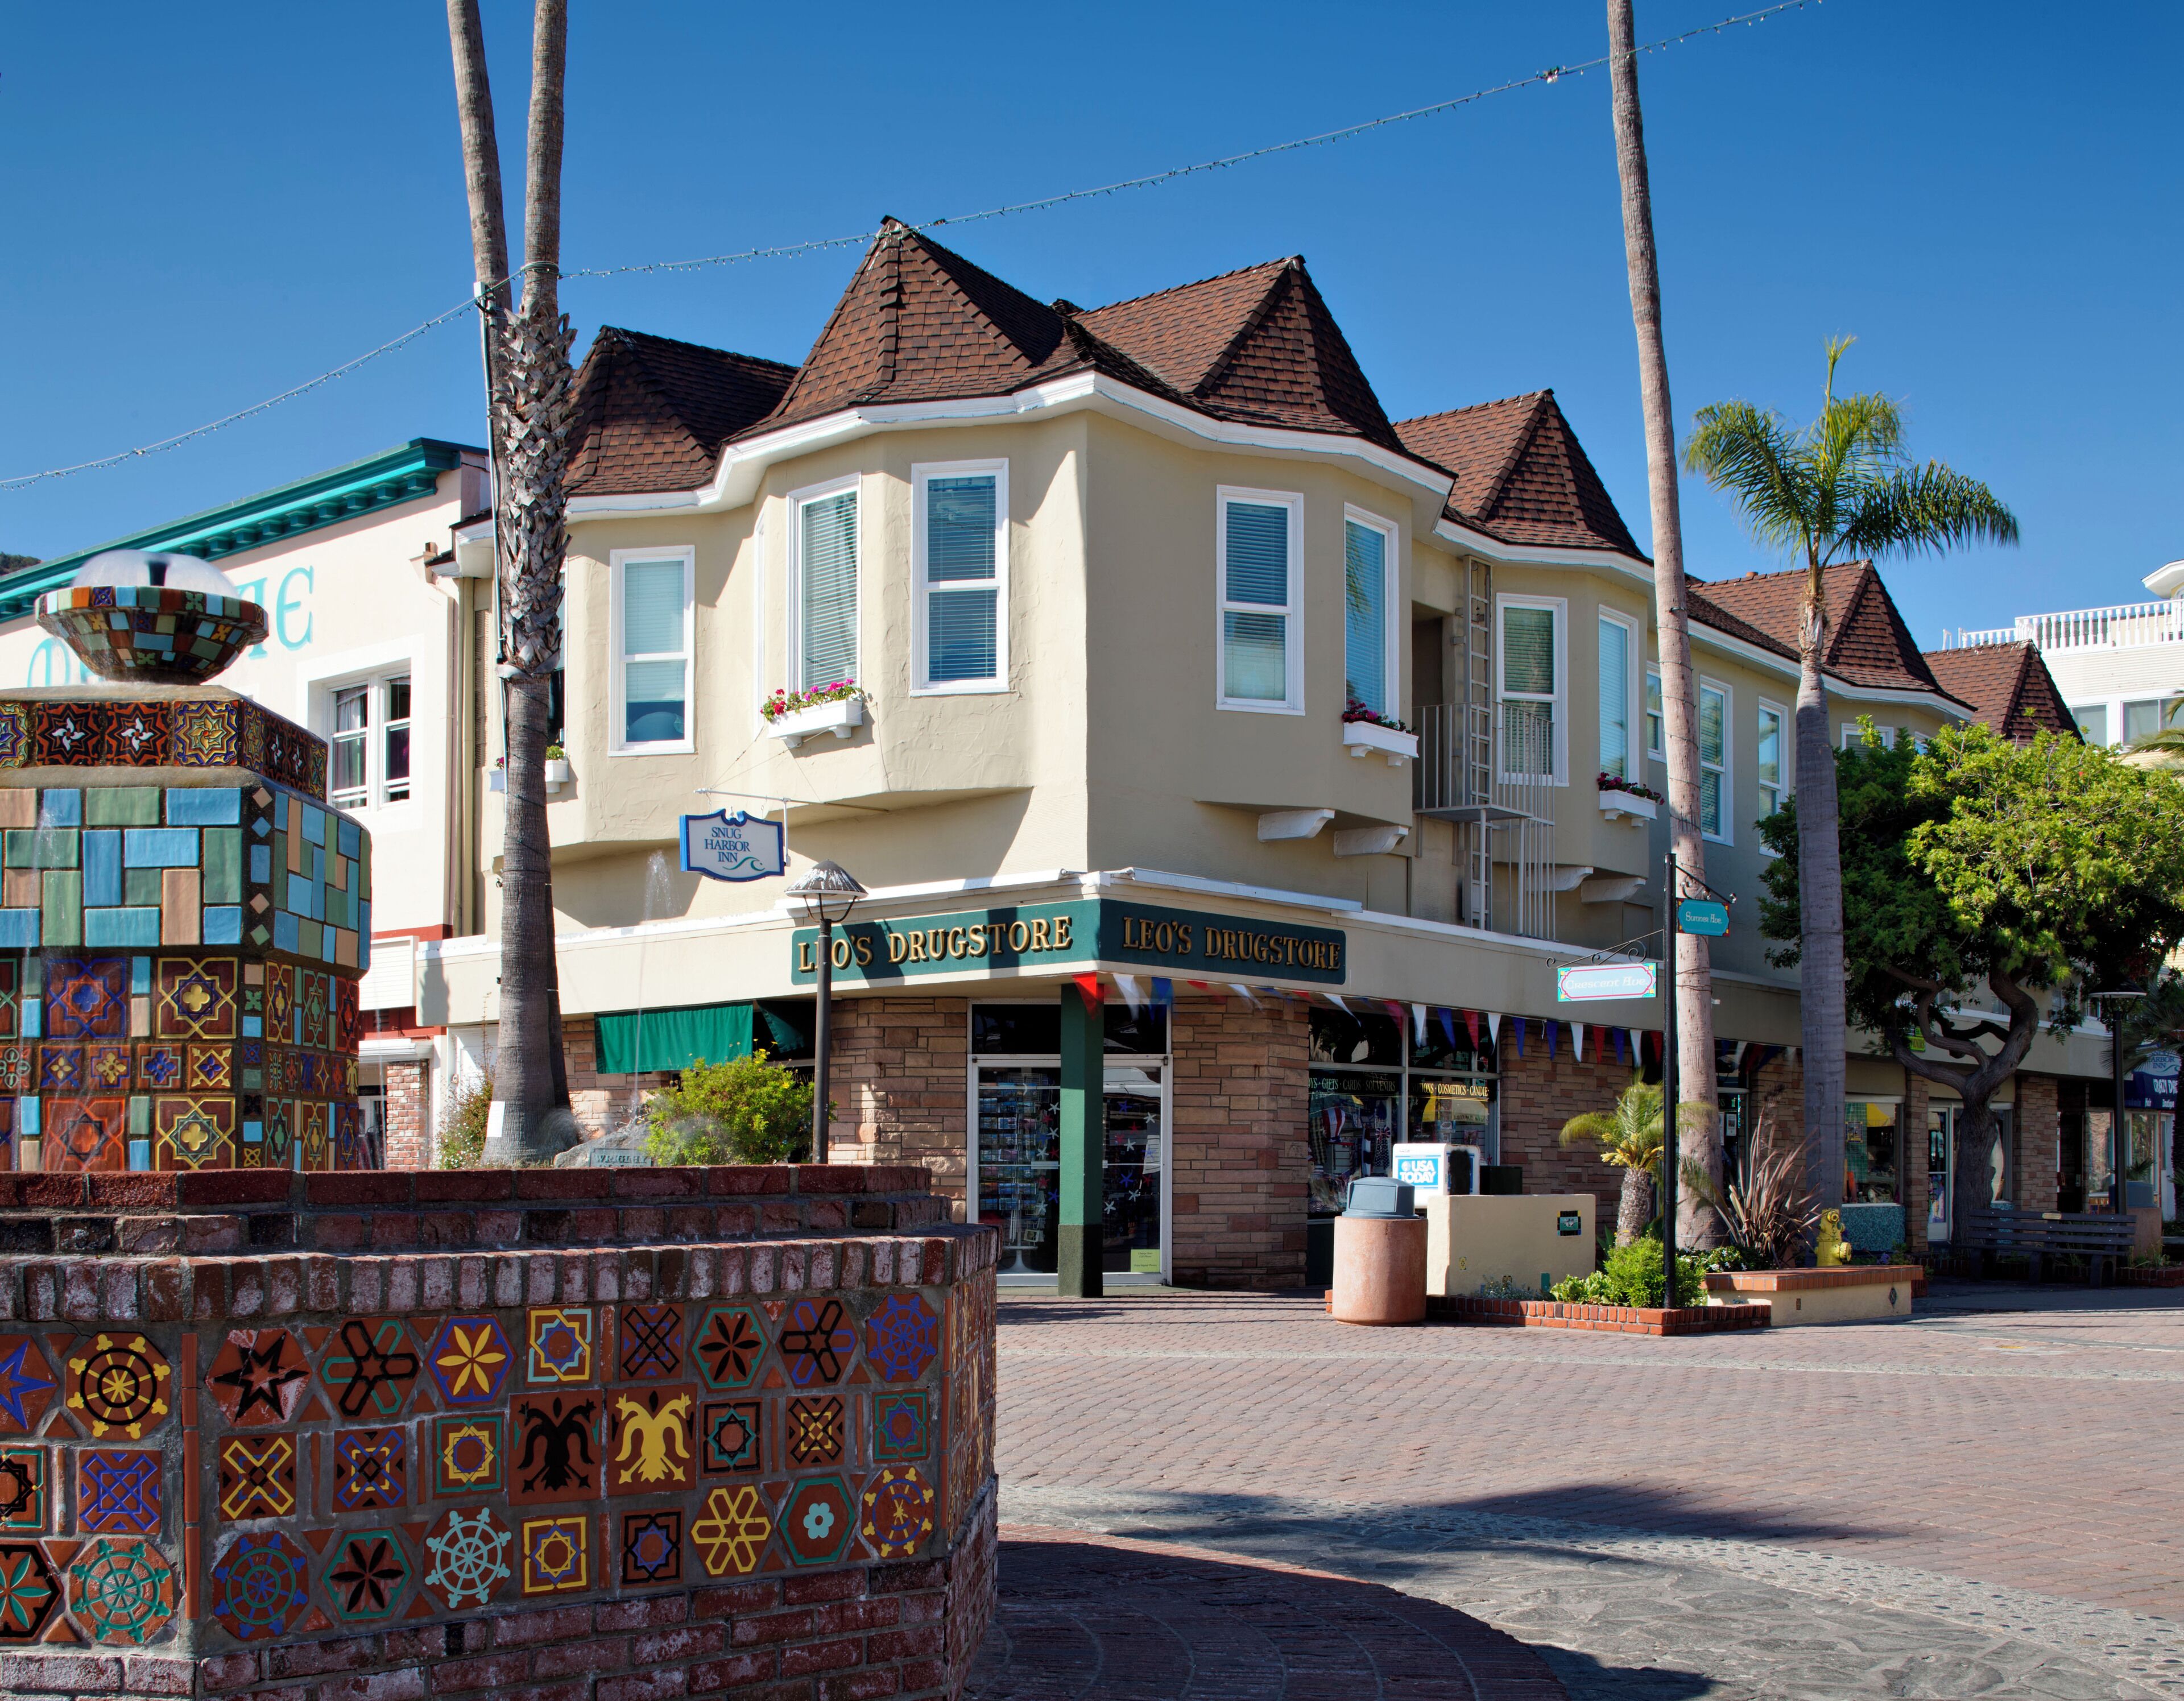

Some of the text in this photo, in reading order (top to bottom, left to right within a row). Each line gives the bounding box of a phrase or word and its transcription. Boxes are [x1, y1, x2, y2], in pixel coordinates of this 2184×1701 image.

[712, 827, 742, 839] SNUG
[704, 839, 751, 851] HARBOR
[718, 852, 738, 862] INN
[1685, 911, 1709, 922] Sumner
[798, 916, 1073, 971] LO'S DRUGSTORE
[1123, 917, 1341, 970] LEO'S DRUGSTORE
[1565, 979, 1620, 990] Crescent
[1308, 1077, 1396, 1091] OYS GIFTS CARDS SOUVENIRS
[1438, 1083, 1466, 1095] COSMETICS
[1470, 1086, 1490, 1096] CANDIE
[1412, 1160, 1435, 1172] USA
[1400, 1172, 1436, 1183] TODAY
